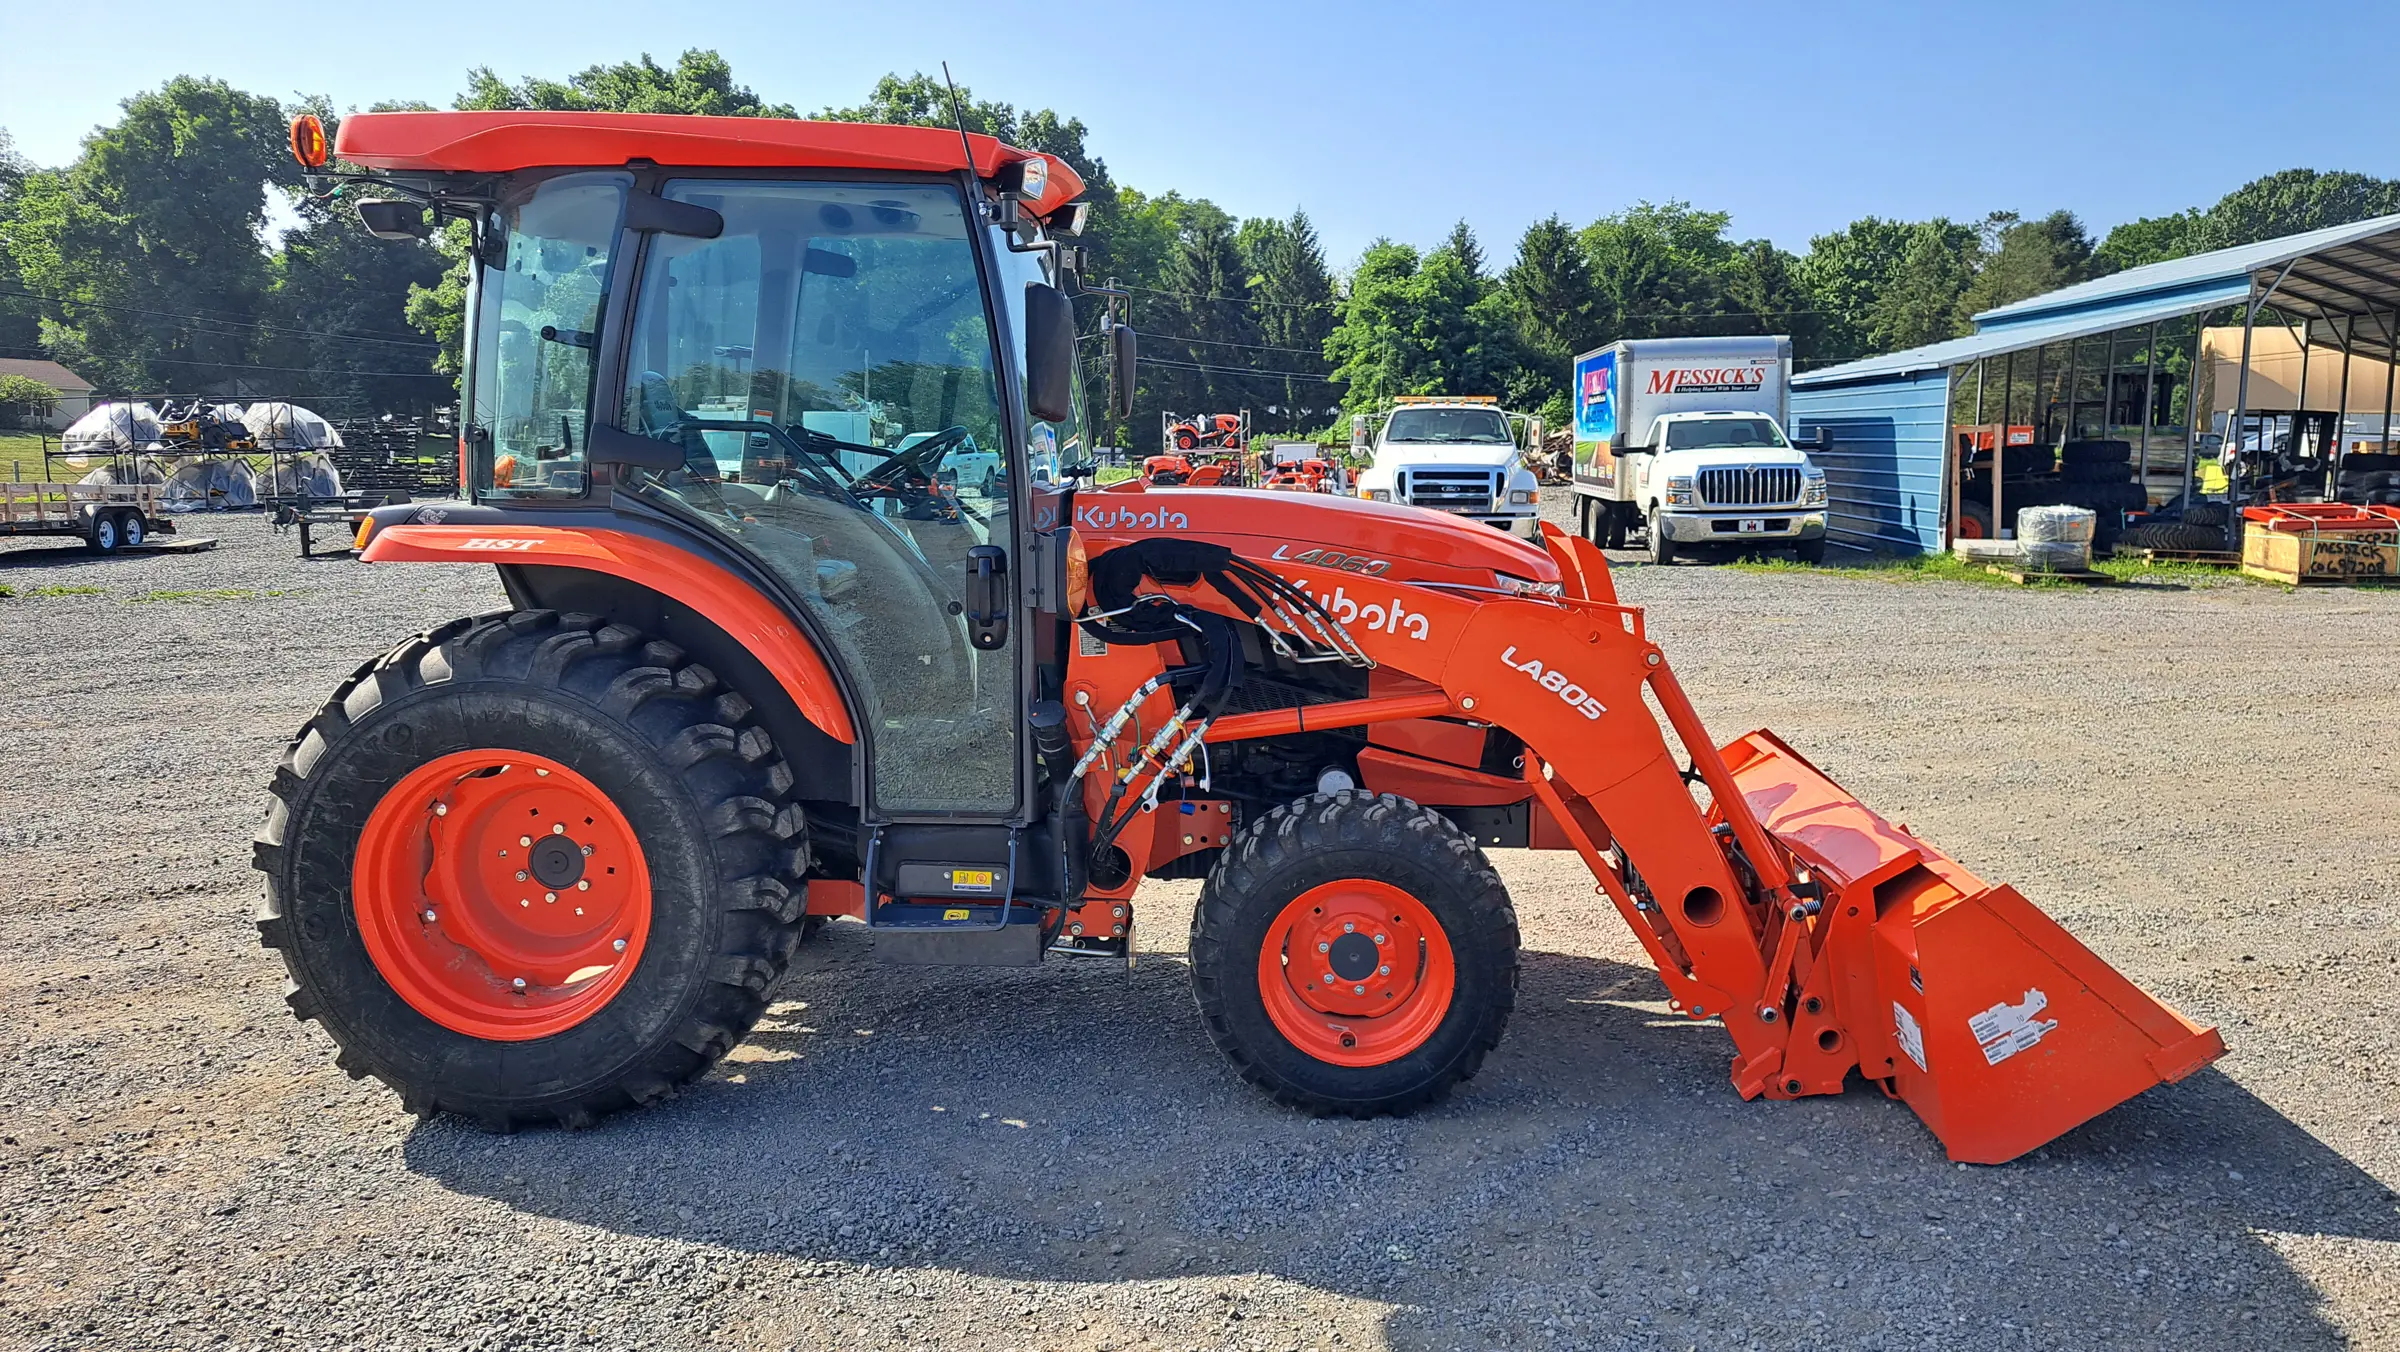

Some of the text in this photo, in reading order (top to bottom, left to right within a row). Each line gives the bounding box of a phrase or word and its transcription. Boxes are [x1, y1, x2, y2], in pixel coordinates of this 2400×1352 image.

[1645, 367, 1766, 395] MESSICK'S
[1681, 386, 1701, 394] Helping
[1731, 384, 1743, 392] Your
[1077, 505, 1188, 529] Kubota
[457, 538, 545, 551] HST
[1271, 544, 1392, 576] L4060
[1500, 645, 1608, 720] LA805
